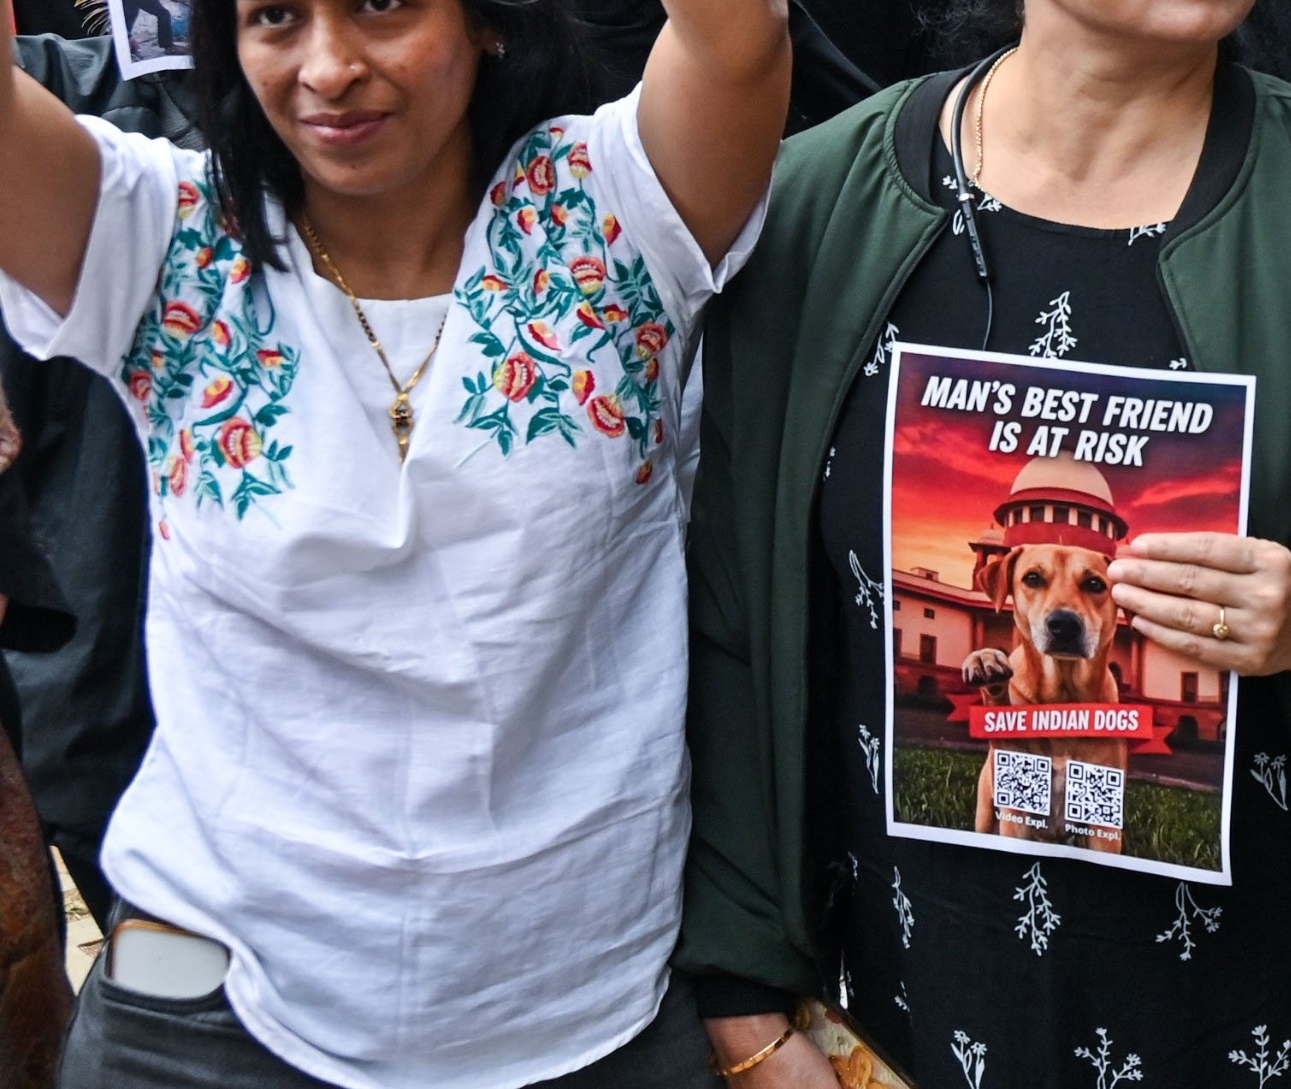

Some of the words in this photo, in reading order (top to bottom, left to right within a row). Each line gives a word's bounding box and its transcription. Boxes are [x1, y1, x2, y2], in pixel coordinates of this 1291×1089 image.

[920, 375, 1016, 415] MAN'S
[1020, 385, 1098, 425] BEST
[1102, 395, 1214, 434] FRIEND
[988, 420, 1022, 454] IS
[1027, 425, 1070, 458] AT
[1073, 431, 1150, 468] RISK
[984, 711, 1027, 733] SAVE
[1032, 710, 1090, 731] INDIAN
[1093, 709, 1140, 731] DOGS
[995, 811, 1023, 826] Video
[1025, 815, 1048, 830] Expl.
[1065, 823, 1094, 838] Photo
[1096, 828, 1121, 842] Expl.
